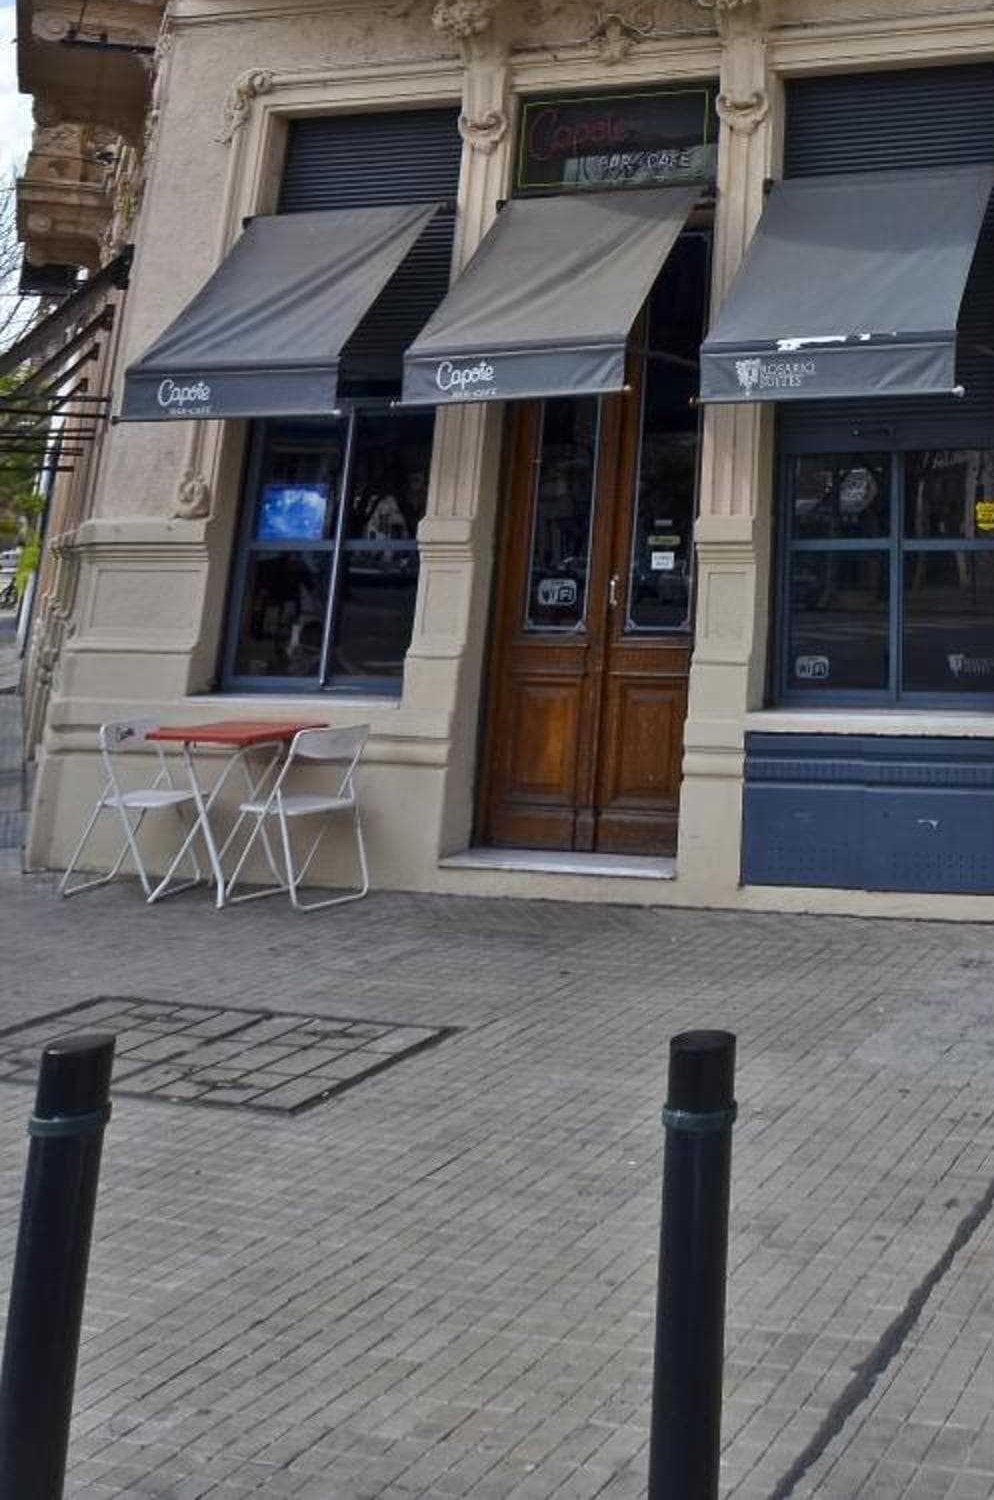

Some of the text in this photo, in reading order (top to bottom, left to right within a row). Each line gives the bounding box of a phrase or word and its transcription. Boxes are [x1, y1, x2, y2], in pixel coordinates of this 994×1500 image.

[437, 361, 495, 390] Capote
[761, 361, 816, 376] ROSARIO
[760, 374, 802, 388] SUITES
[158, 379, 210, 406] Capote
